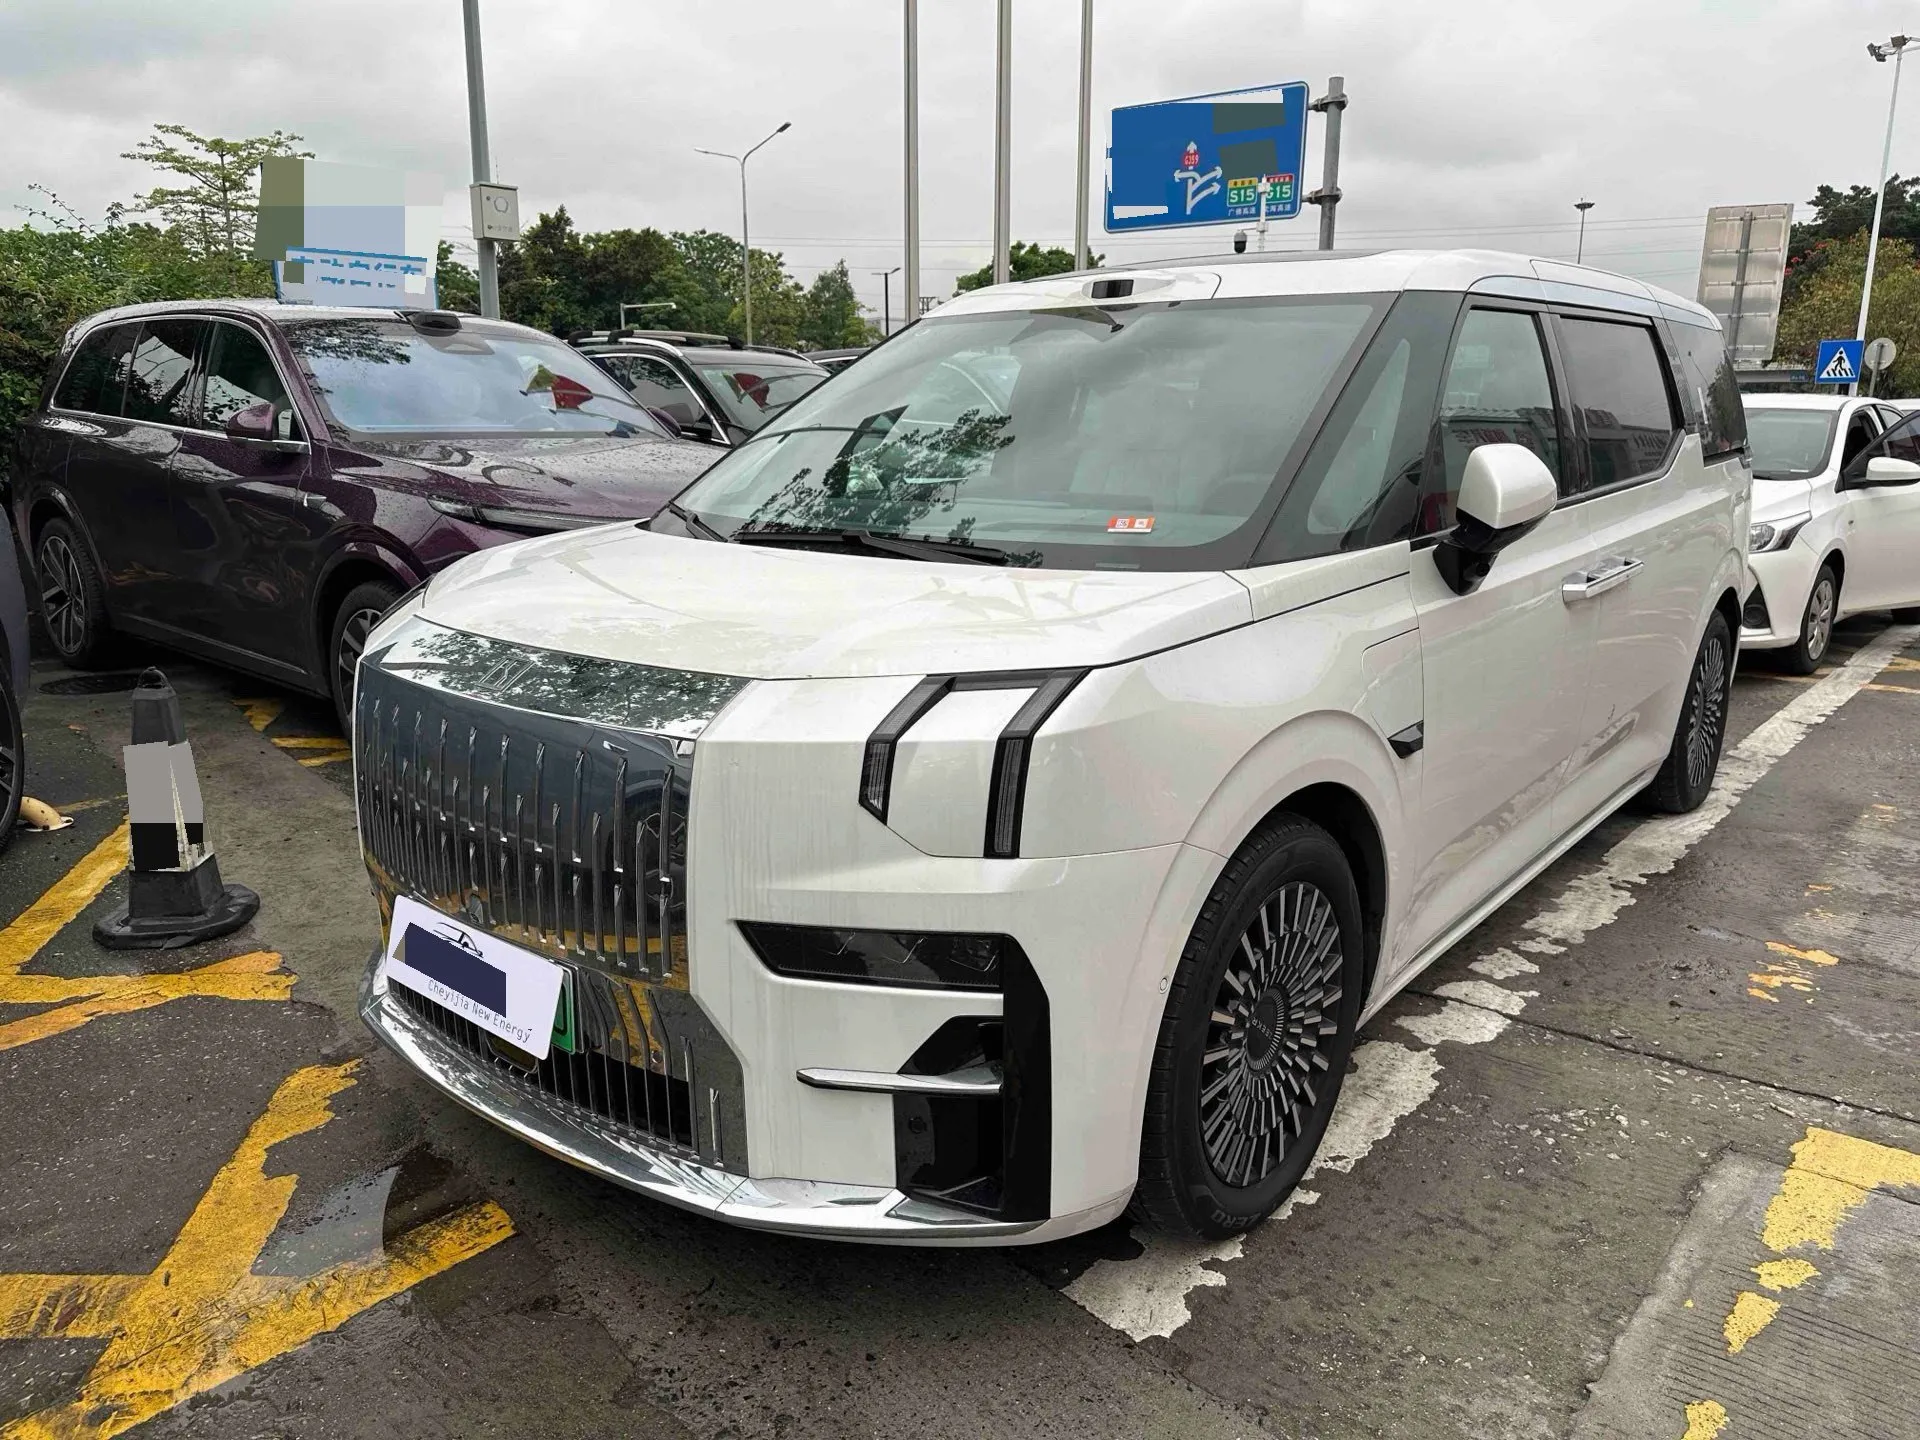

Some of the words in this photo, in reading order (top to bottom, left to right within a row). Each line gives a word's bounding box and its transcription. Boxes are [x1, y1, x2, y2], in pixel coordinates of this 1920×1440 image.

[1184, 153, 1199, 165] G359
[1229, 188, 1255, 203] S15
[1266, 185, 1291, 199] G15
[428, 979, 470, 1011] Cheyijia
[472, 1002, 490, 1021] New
[494, 1017, 531, 1044] Energy
[1251, 1016, 1273, 1040] ZEEKR
